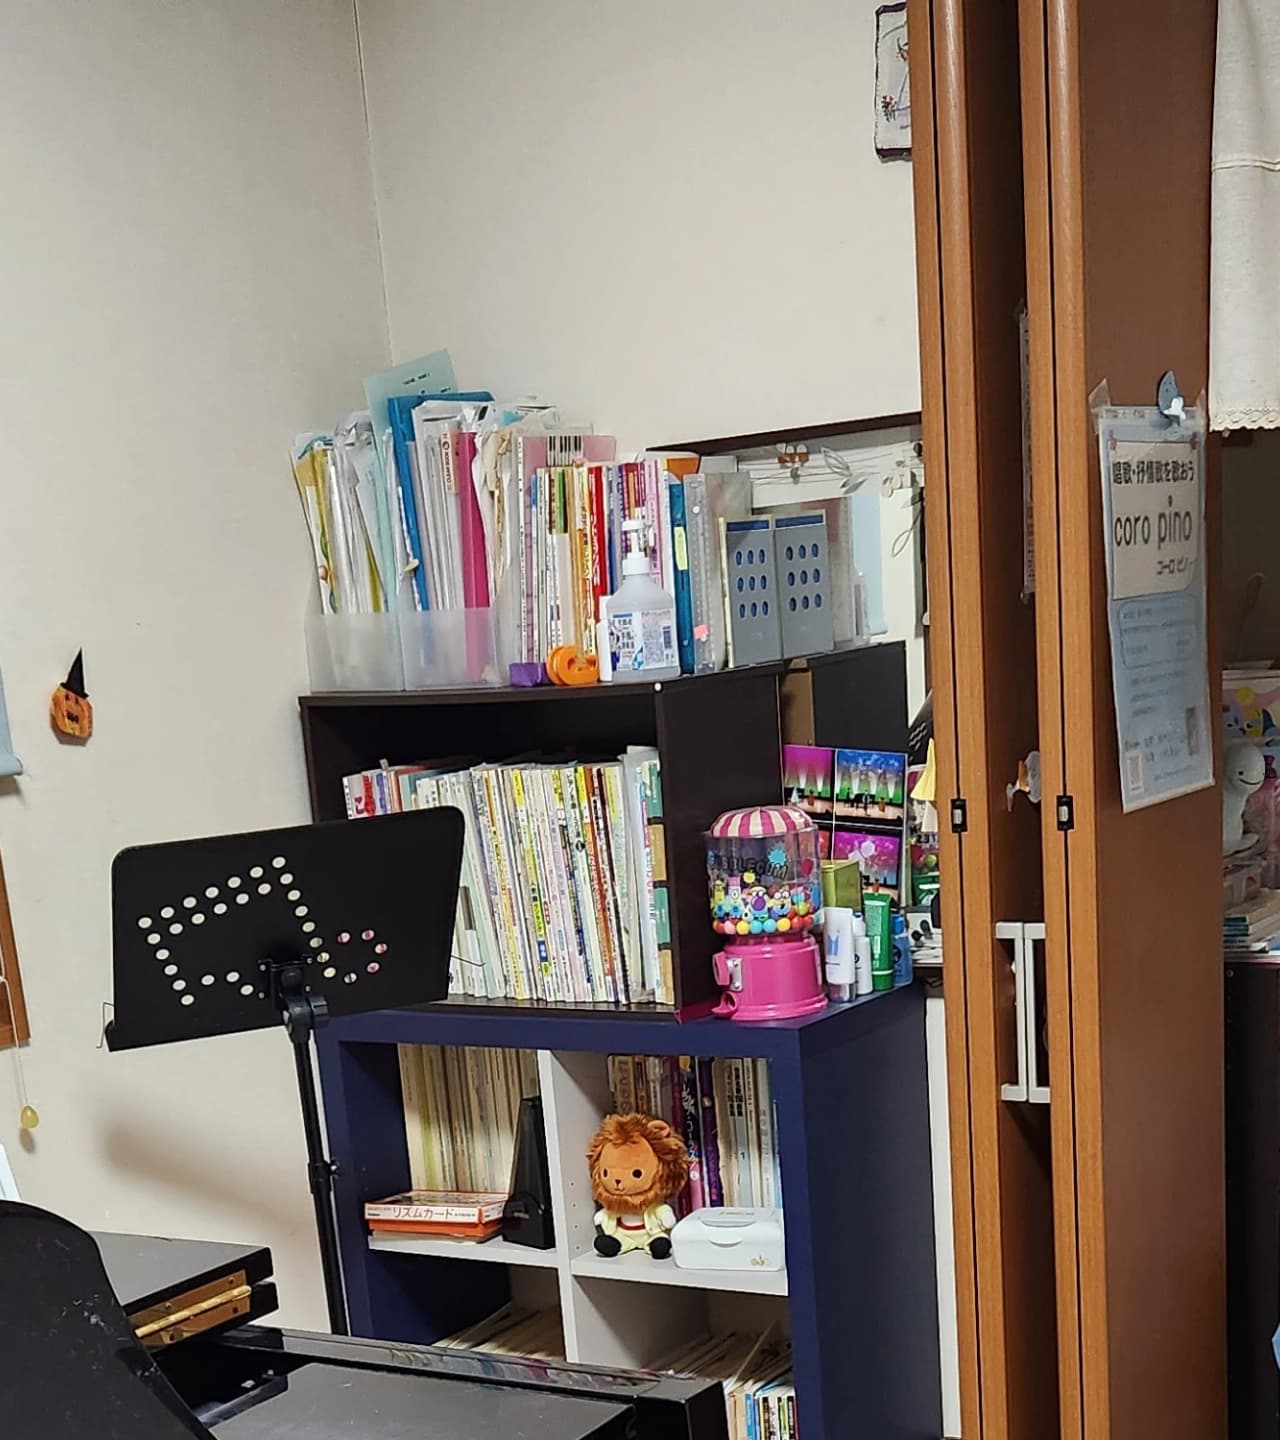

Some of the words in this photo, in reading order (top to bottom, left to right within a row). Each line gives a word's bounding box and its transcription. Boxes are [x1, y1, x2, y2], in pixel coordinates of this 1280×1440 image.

[1113, 512, 1151, 547] coro
[1157, 496, 1193, 551] pino
[392, 1206, 455, 1220] リズムカード
